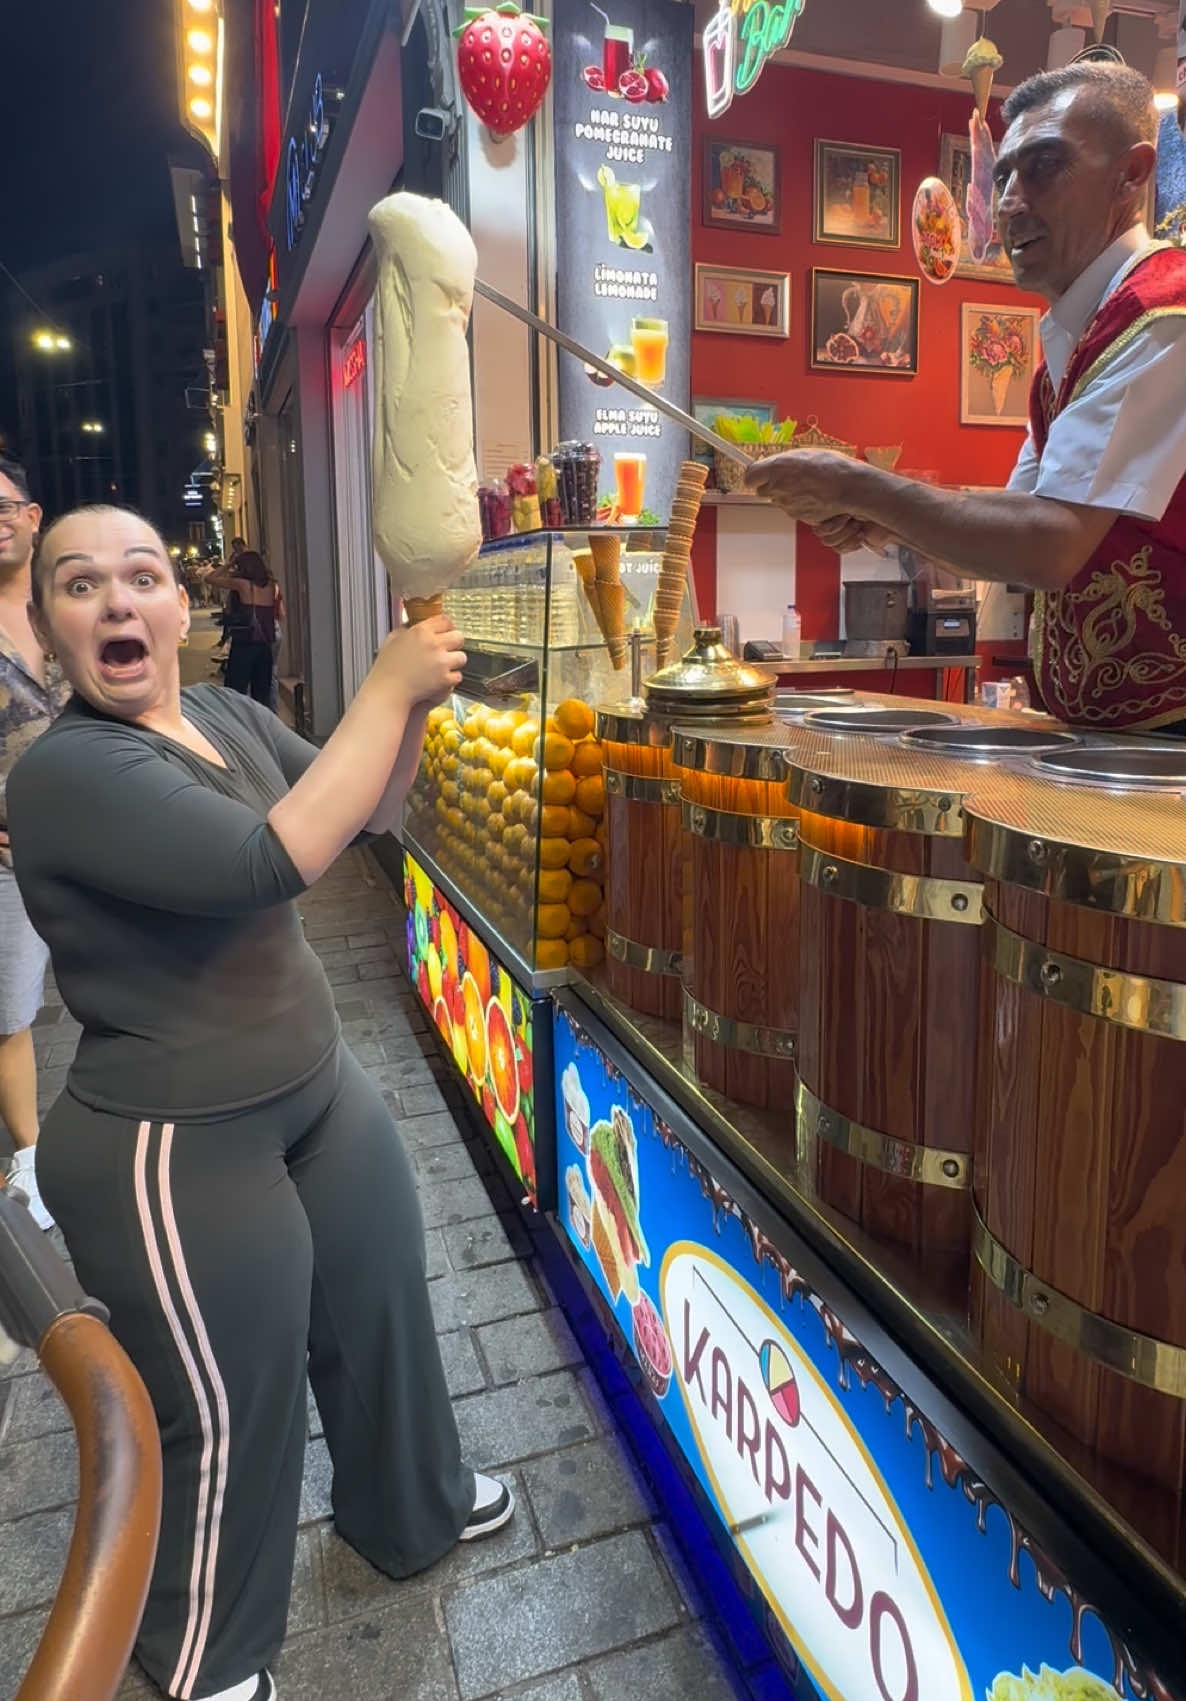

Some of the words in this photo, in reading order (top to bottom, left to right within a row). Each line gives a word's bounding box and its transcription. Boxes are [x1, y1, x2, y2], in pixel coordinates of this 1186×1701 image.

[591, 110, 619, 127] NAR
[623, 113, 659, 132] SUYU
[575, 124, 673, 151] POMEGRANATE
[606, 148, 644, 163] JUICE
[594, 265, 657, 285] LİMONATA
[594, 284, 657, 300] LEMONADE
[596, 409, 626, 422] ELMA
[628, 410, 658, 424] SUYU
[593, 422, 627, 435] APPLE
[630, 423, 661, 437] JUICE
[683, 1298, 919, 1701] KARPEDO
